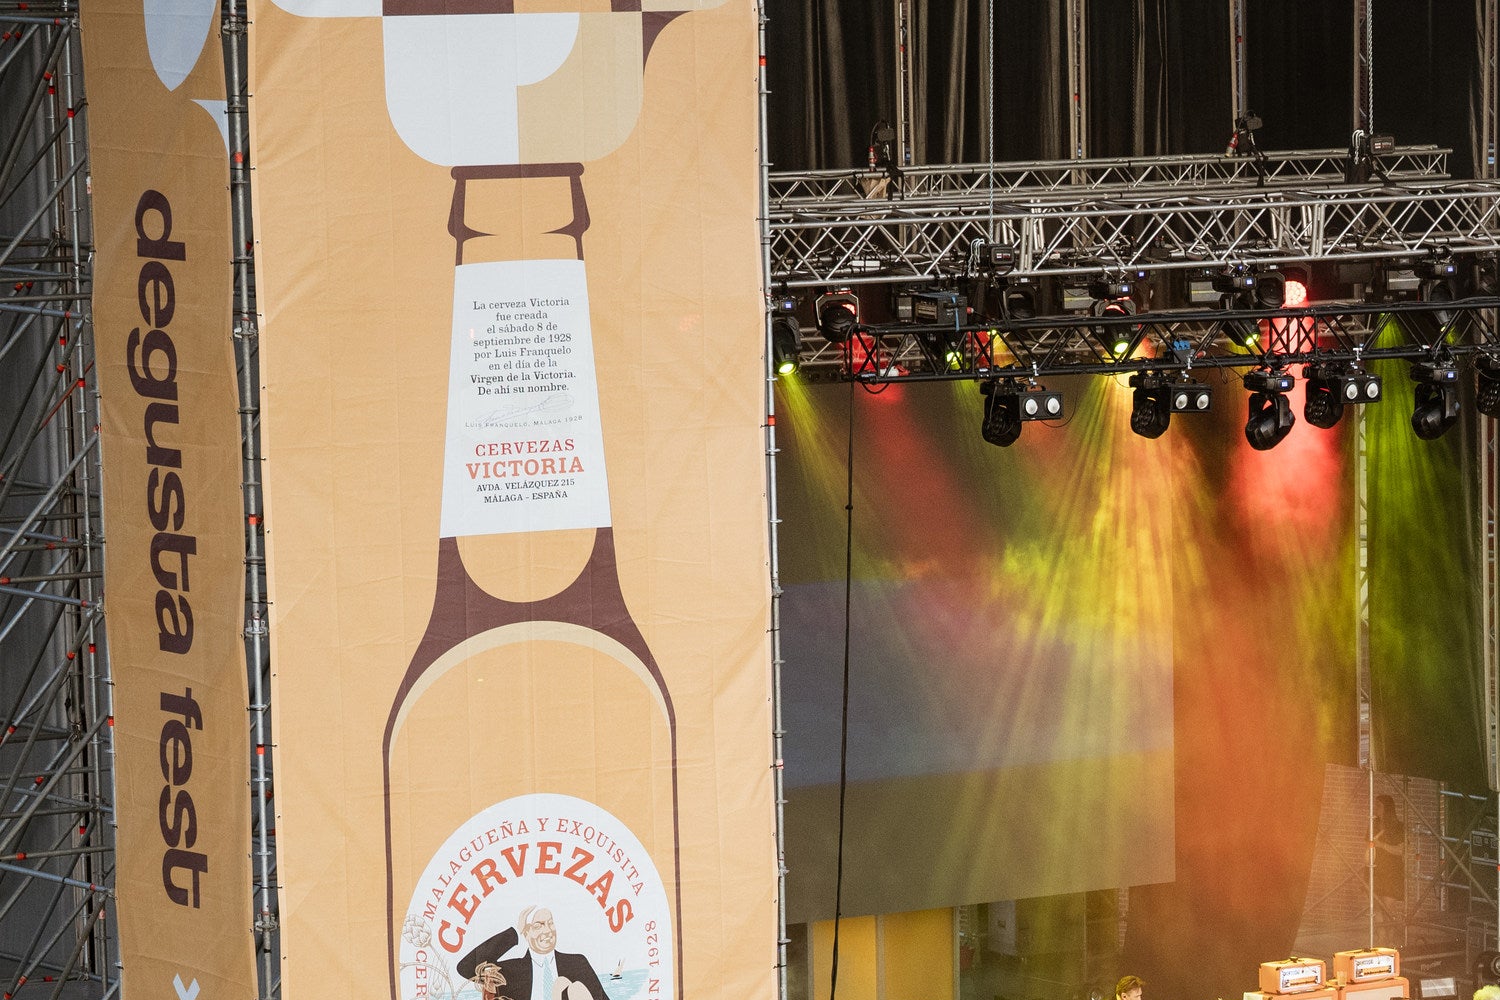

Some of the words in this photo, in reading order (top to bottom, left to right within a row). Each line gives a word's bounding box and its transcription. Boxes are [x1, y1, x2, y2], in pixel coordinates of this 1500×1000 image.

[473, 301, 485, 310] La
[530, 297, 569, 307] Victoria
[496, 313, 511, 321] fue
[514, 311, 548, 320] creada
[487, 325, 495, 334] el
[499, 323, 534, 333] sábado
[537, 323, 543, 331] 8
[546, 322, 557, 330] de
[473, 336, 530, 349] septiembre
[534, 335, 545, 343] de
[549, 333, 571, 342] 1928
[474, 352, 491, 361] por
[495, 349, 517, 358] Luis
[520, 346, 571, 358] Franquelo
[504, 361, 512, 369] el
[515, 360, 530, 368] día
[534, 359, 545, 367] de
[549, 359, 557, 367] la
[470, 374, 503, 385] Virgen
[507, 373, 518, 381] de
[521, 372, 530, 380] la
[533, 370, 576, 380] Victoria.
[478, 387, 491, 395] De
[494, 385, 510, 394] ahí
[528, 383, 569, 392] nombre.
[127, 189, 198, 655] degusta
[475, 439, 575, 456] CERVEZAS
[466, 456, 584, 479] VICTORIA
[505, 479, 559, 490] VELÁZQUEZ
[484, 494, 523, 503] MÁLAGA
[532, 490, 568, 500] ESPAÑA
[159, 686, 208, 908] fest
[423, 820, 530, 922] MALAGUEÑA
[536, 817, 550, 832] Y
[556, 818, 645, 897] EXQUISITA
[437, 841, 635, 954] CERVEZAS
[644, 920, 659, 967] 1928
